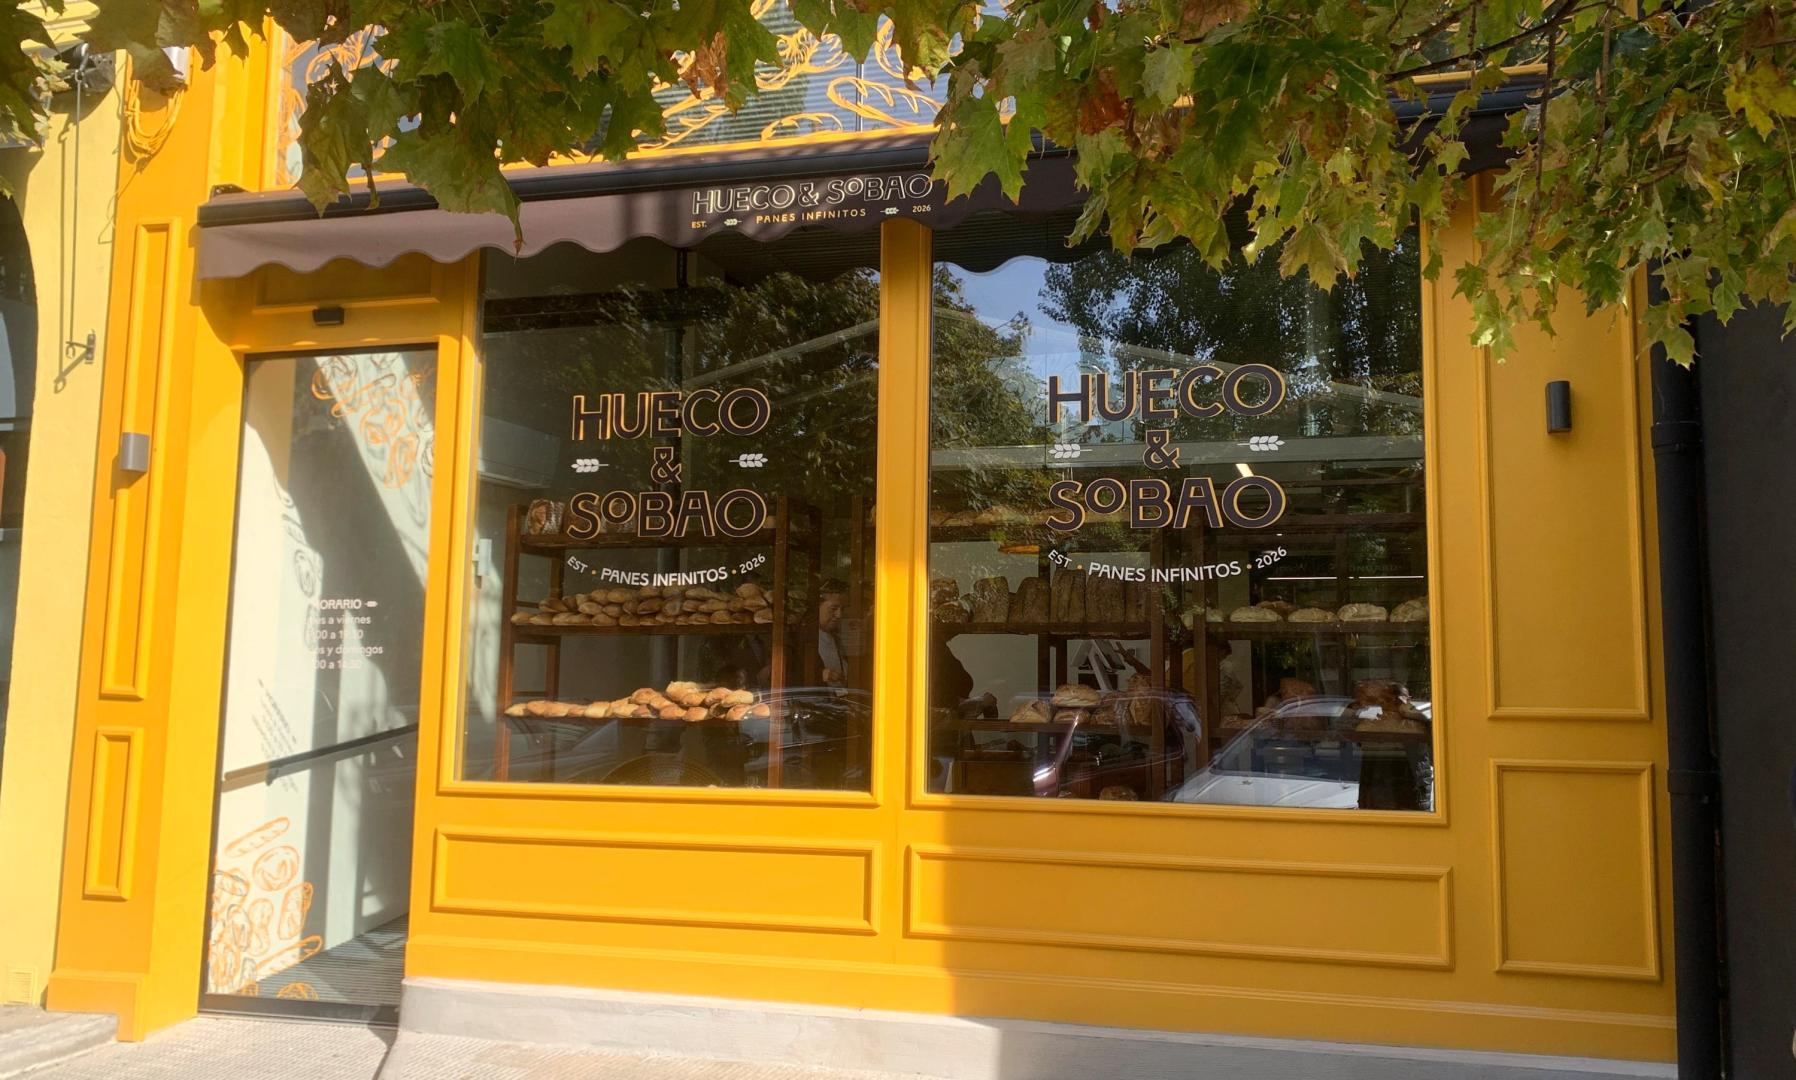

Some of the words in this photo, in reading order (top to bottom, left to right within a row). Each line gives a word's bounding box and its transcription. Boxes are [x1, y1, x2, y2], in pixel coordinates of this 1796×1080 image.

[691, 220, 708, 229] EST.
[756, 213, 796, 224] PANES
[801, 208, 866, 221] INFINITOS
[912, 204, 932, 213] 2026
[692, 184, 795, 215] HUECO
[798, 181, 819, 208] &
[1048, 363, 1286, 423] HUECO
[571, 387, 771, 441] HUECO
[650, 446, 682, 484] &
[1142, 429, 1180, 470] &
[566, 488, 767, 540] SOBAO
[1045, 475, 1287, 532] SOBAO
[566, 555, 588, 574] EST
[600, 567, 649, 586] PANES
[652, 566, 728, 587] INFINITOS
[739, 553, 766, 574] 2026
[1047, 548, 1073, 568] EST
[1088, 562, 1146, 582] PANES
[1151, 560, 1242, 583] INFINITOS
[1255, 545, 1288, 570] 2026
[336, 614, 371, 625] vines
